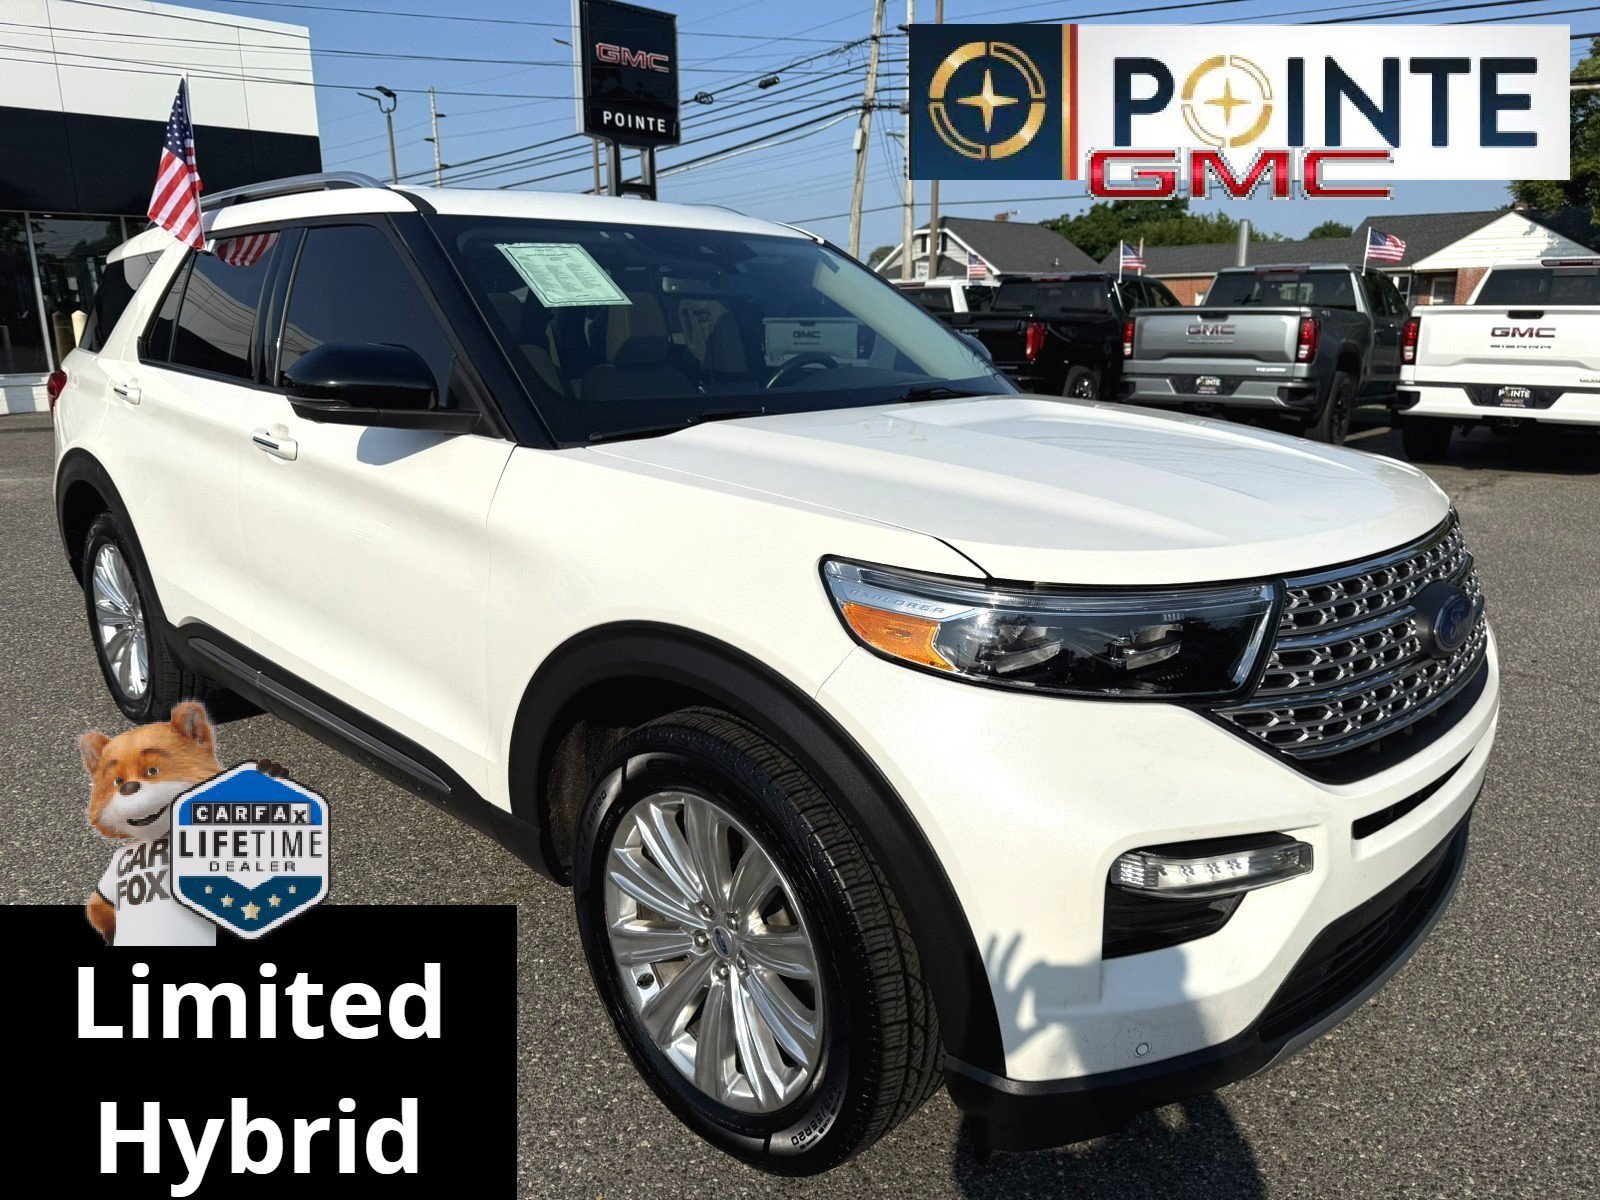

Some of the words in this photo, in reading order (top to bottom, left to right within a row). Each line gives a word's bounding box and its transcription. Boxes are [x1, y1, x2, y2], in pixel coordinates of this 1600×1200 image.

[595, 42, 669, 73] GMC
[602, 110, 666, 133] POINTE
[793, 331, 821, 339] GMC
[1187, 324, 1237, 336] GMC
[1490, 327, 1556, 338] GMC
